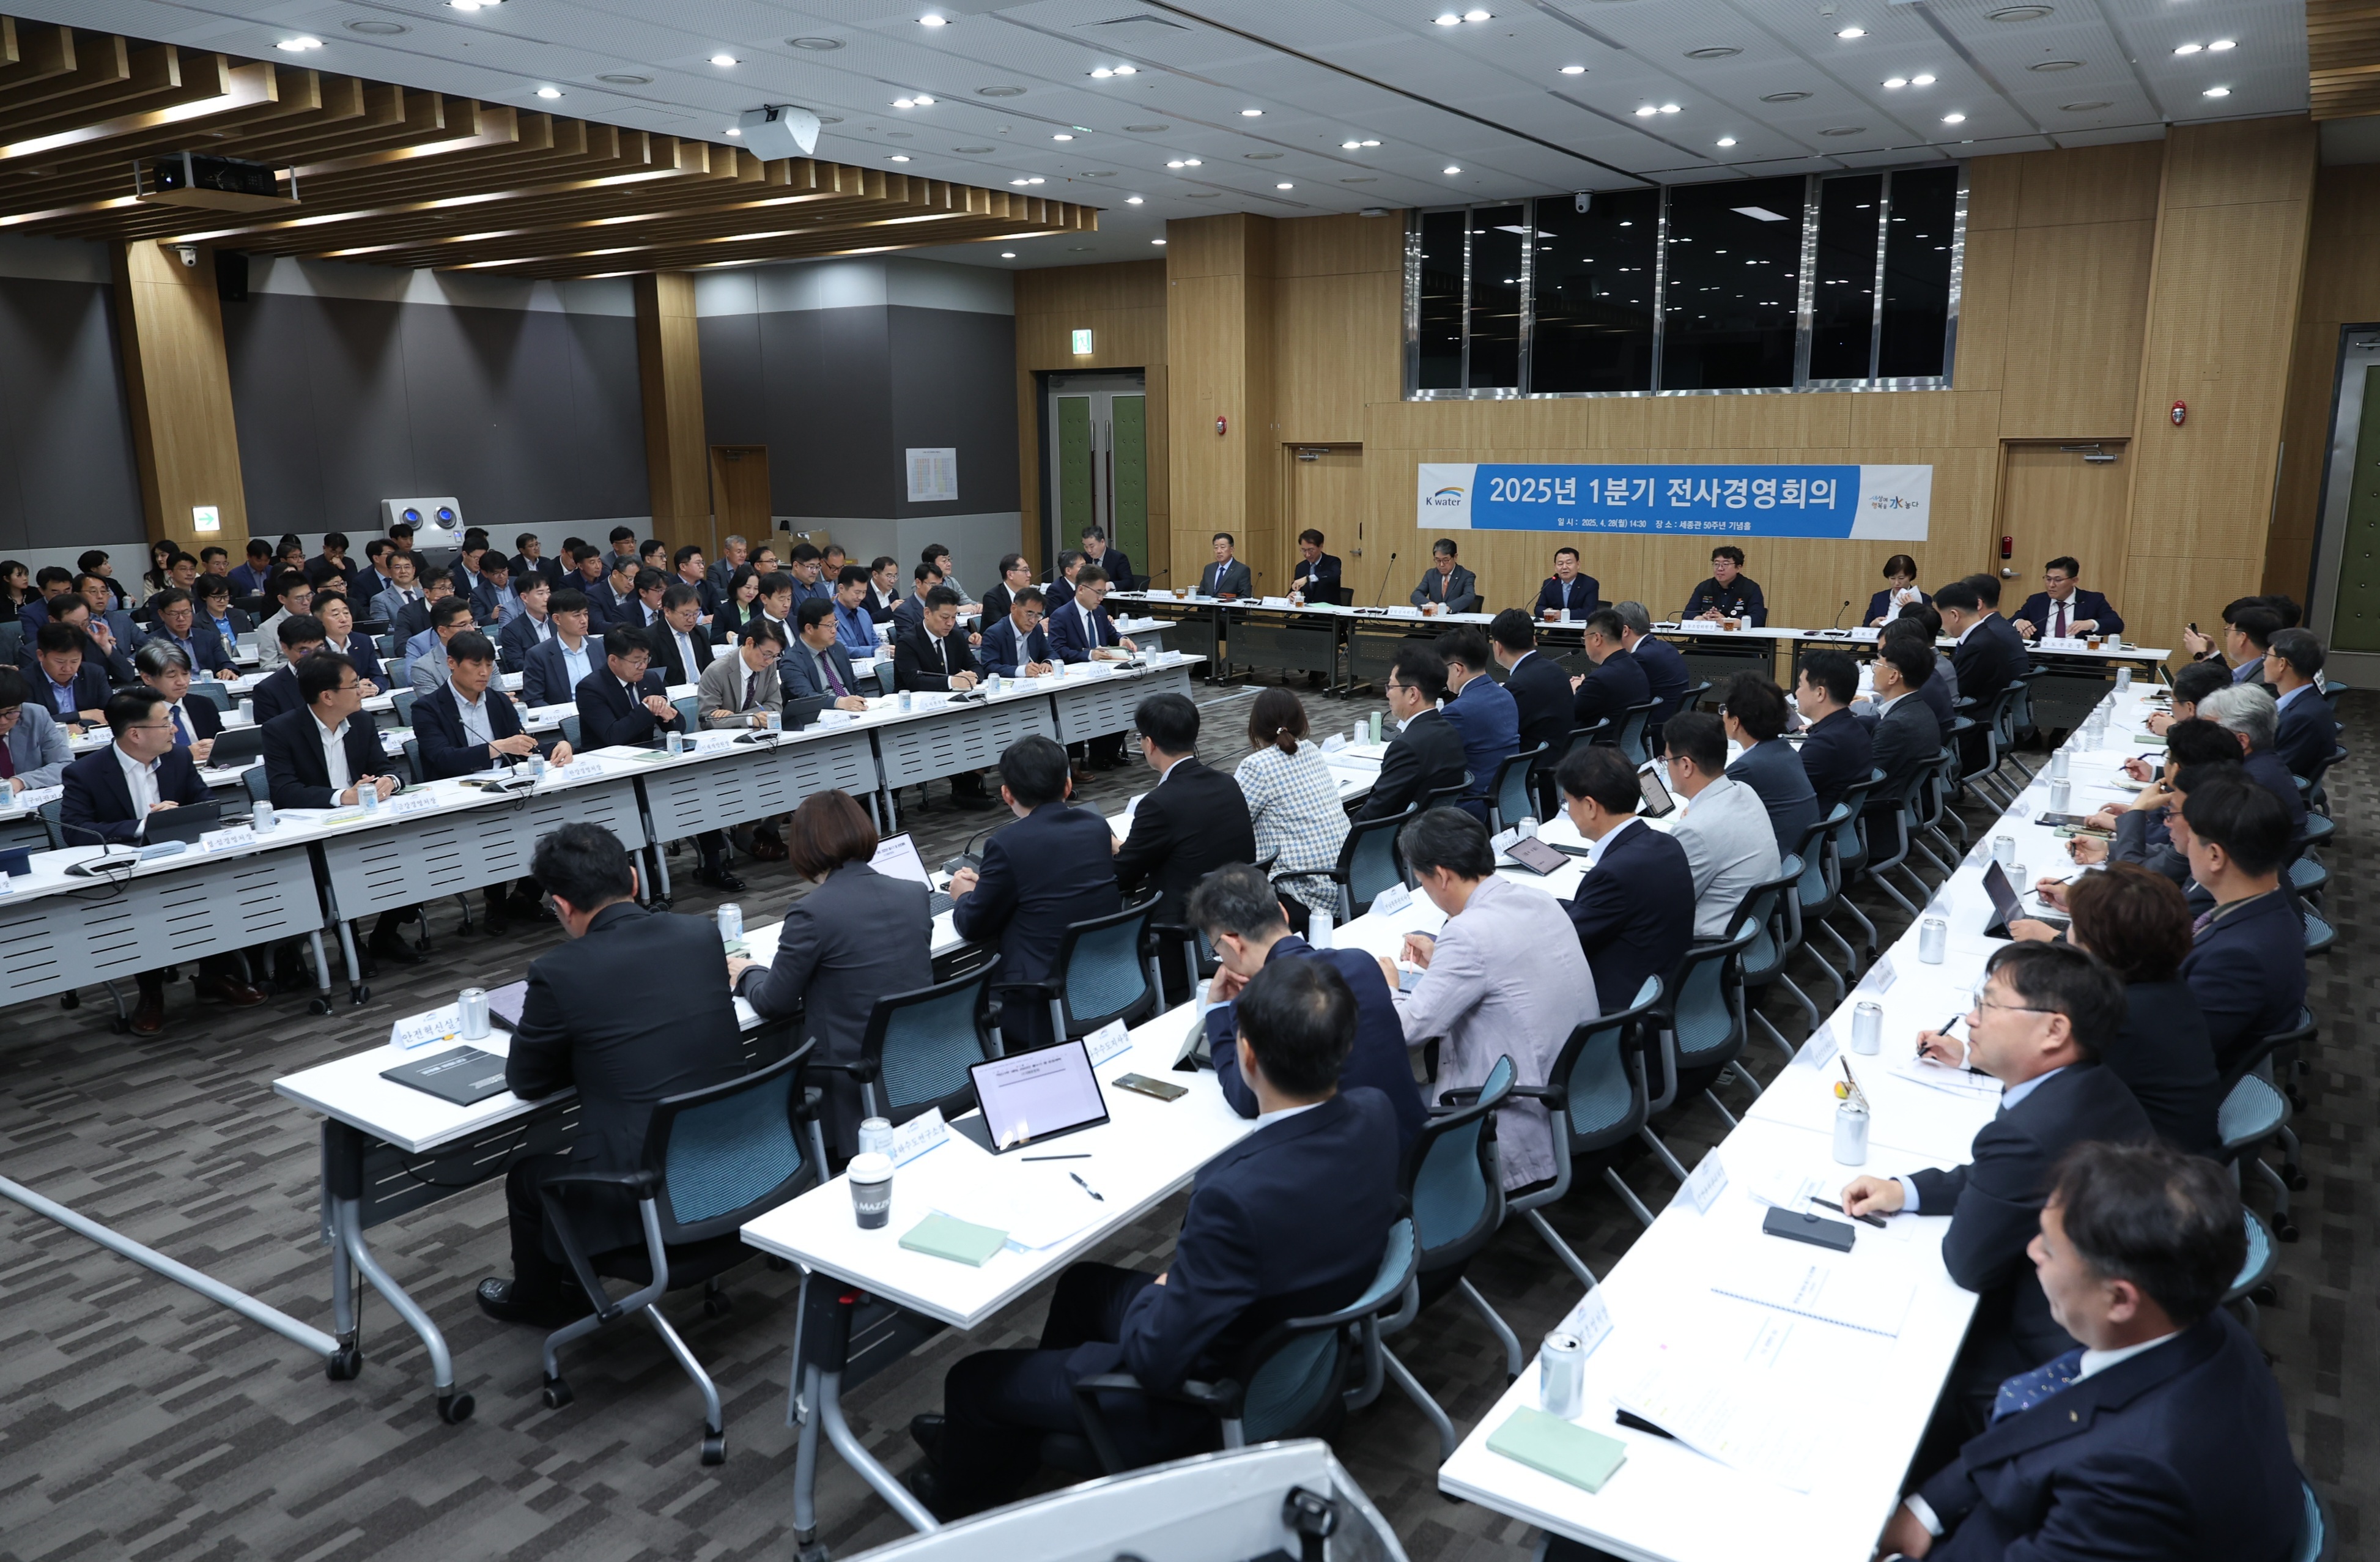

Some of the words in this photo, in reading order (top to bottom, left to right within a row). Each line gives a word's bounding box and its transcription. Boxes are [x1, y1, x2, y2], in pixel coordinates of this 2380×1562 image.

[1490, 477, 1576, 505] 2025년
[1589, 478, 1655, 507] 1분기
[1666, 478, 1836, 509] 전사경영회의
[1435, 498, 1461, 506] water
[1889, 495, 1904, 509] 水
[1905, 501, 1919, 509] 놓다
[1608, 519, 1628, 528] 28(월)
[1679, 520, 1701, 530] 세종관
[1703, 521, 1726, 530] 50주년
[569, 764, 602, 777] 한강경영처장
[397, 797, 436, 810] 금강경영처장
